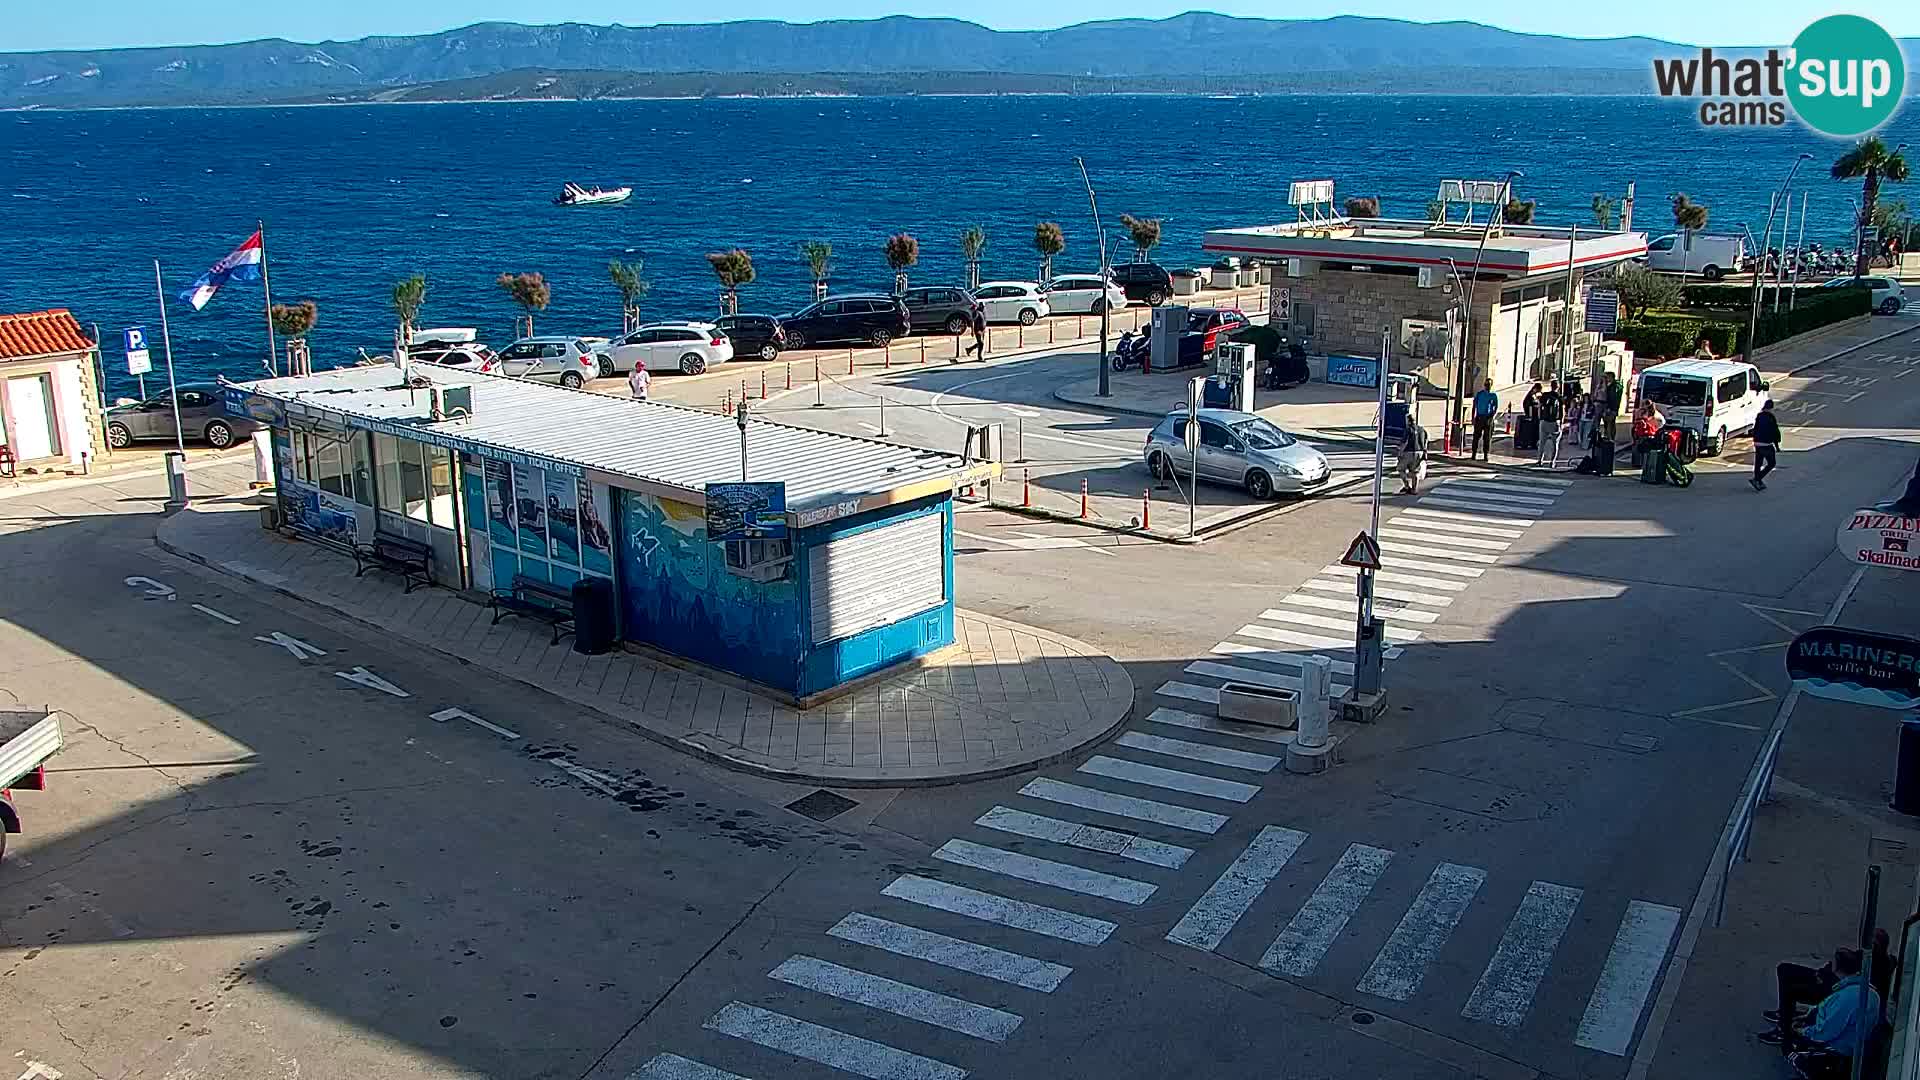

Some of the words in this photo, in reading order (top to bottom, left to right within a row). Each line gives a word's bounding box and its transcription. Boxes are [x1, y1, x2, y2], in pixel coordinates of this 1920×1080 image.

[128, 330, 142, 349] P
[478, 445, 492, 457] BUS
[493, 449, 526, 465] STATION
[528, 457, 554, 470] TICKET
[555, 463, 582, 476] OFFICE
[1847, 514, 1920, 533] PIZZE
[1869, 664, 1896, 679] bar
